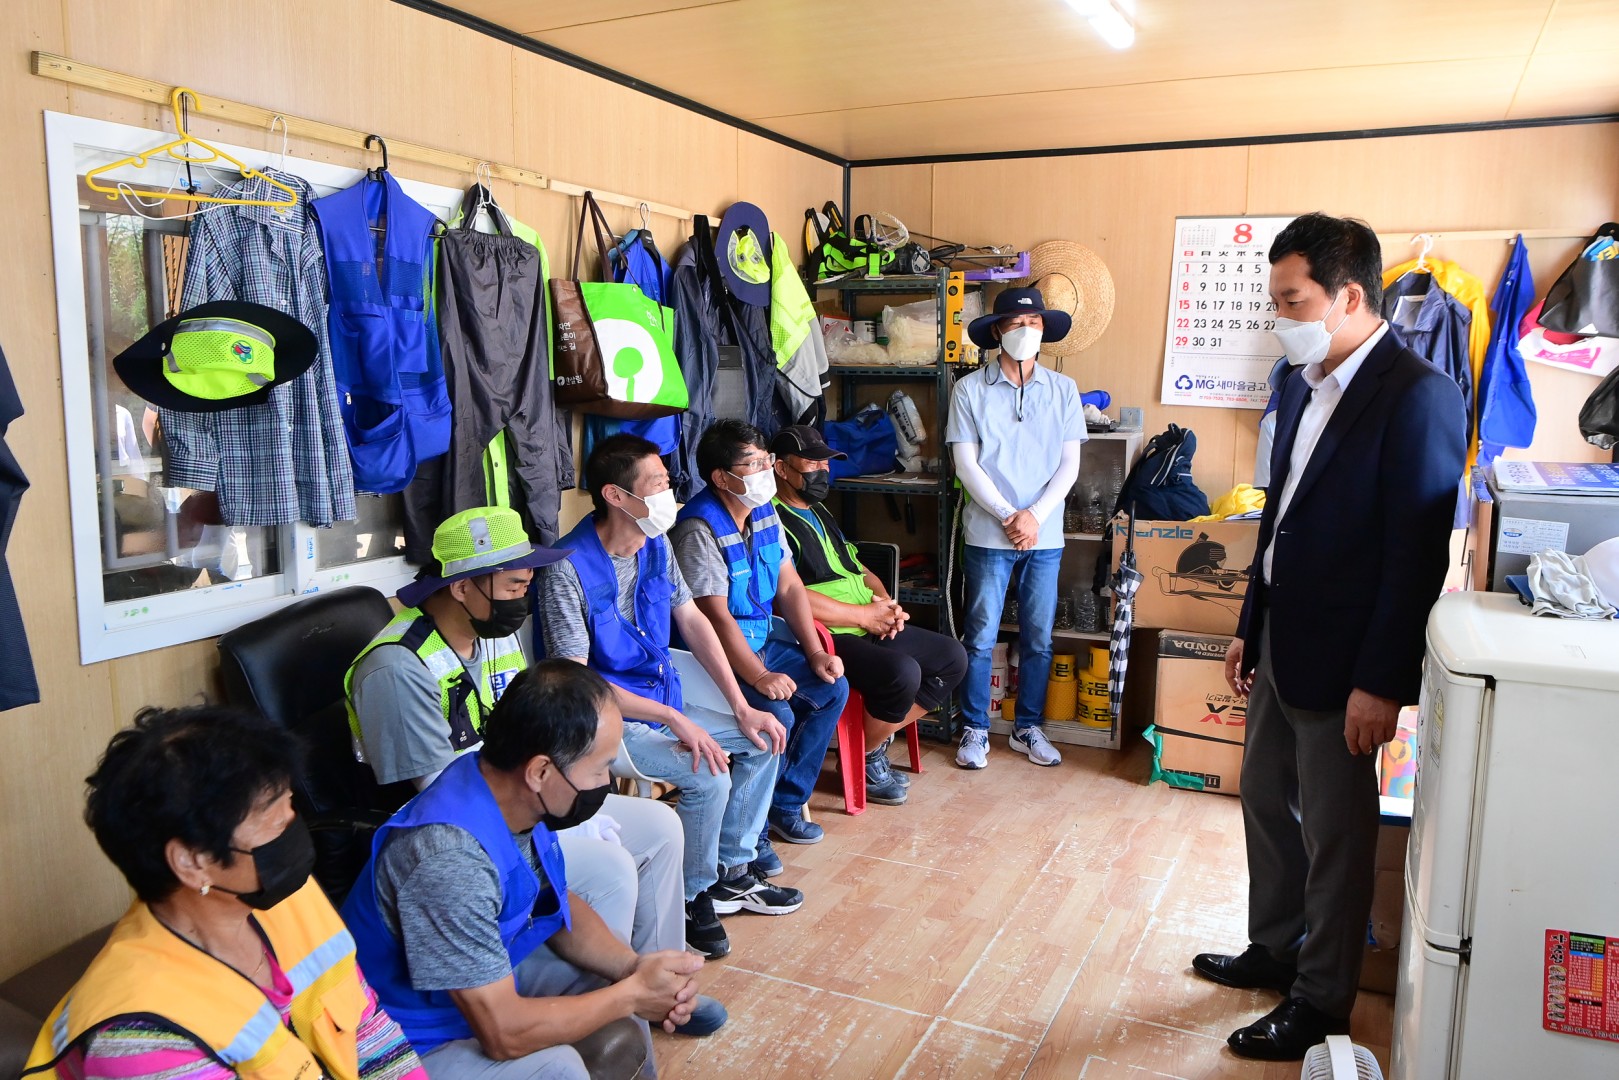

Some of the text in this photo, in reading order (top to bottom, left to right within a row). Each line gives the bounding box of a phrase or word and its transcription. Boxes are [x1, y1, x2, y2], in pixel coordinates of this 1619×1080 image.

[1233, 223, 1253, 244] 8
[1186, 264, 1261, 273] 1 2 3 4 5
[1183, 282, 1262, 292] 8 9 10 11 12
[1179, 300, 1190, 309] 15
[1197, 301, 1207, 309] 16
[1214, 301, 1225, 310] 17
[1231, 301, 1242, 310] 18
[1250, 302, 1260, 311] 19
[1177, 318, 1189, 328] 22
[1194, 319, 1206, 328] 23
[1212, 320, 1223, 328] 24
[1229, 320, 1241, 329] 25
[1247, 320, 1259, 329] 26
[1176, 336, 1221, 347] 29 30 31
[1195, 379, 1267, 391] MG 새마을금고
[1172, 640, 1229, 653] HONDA
